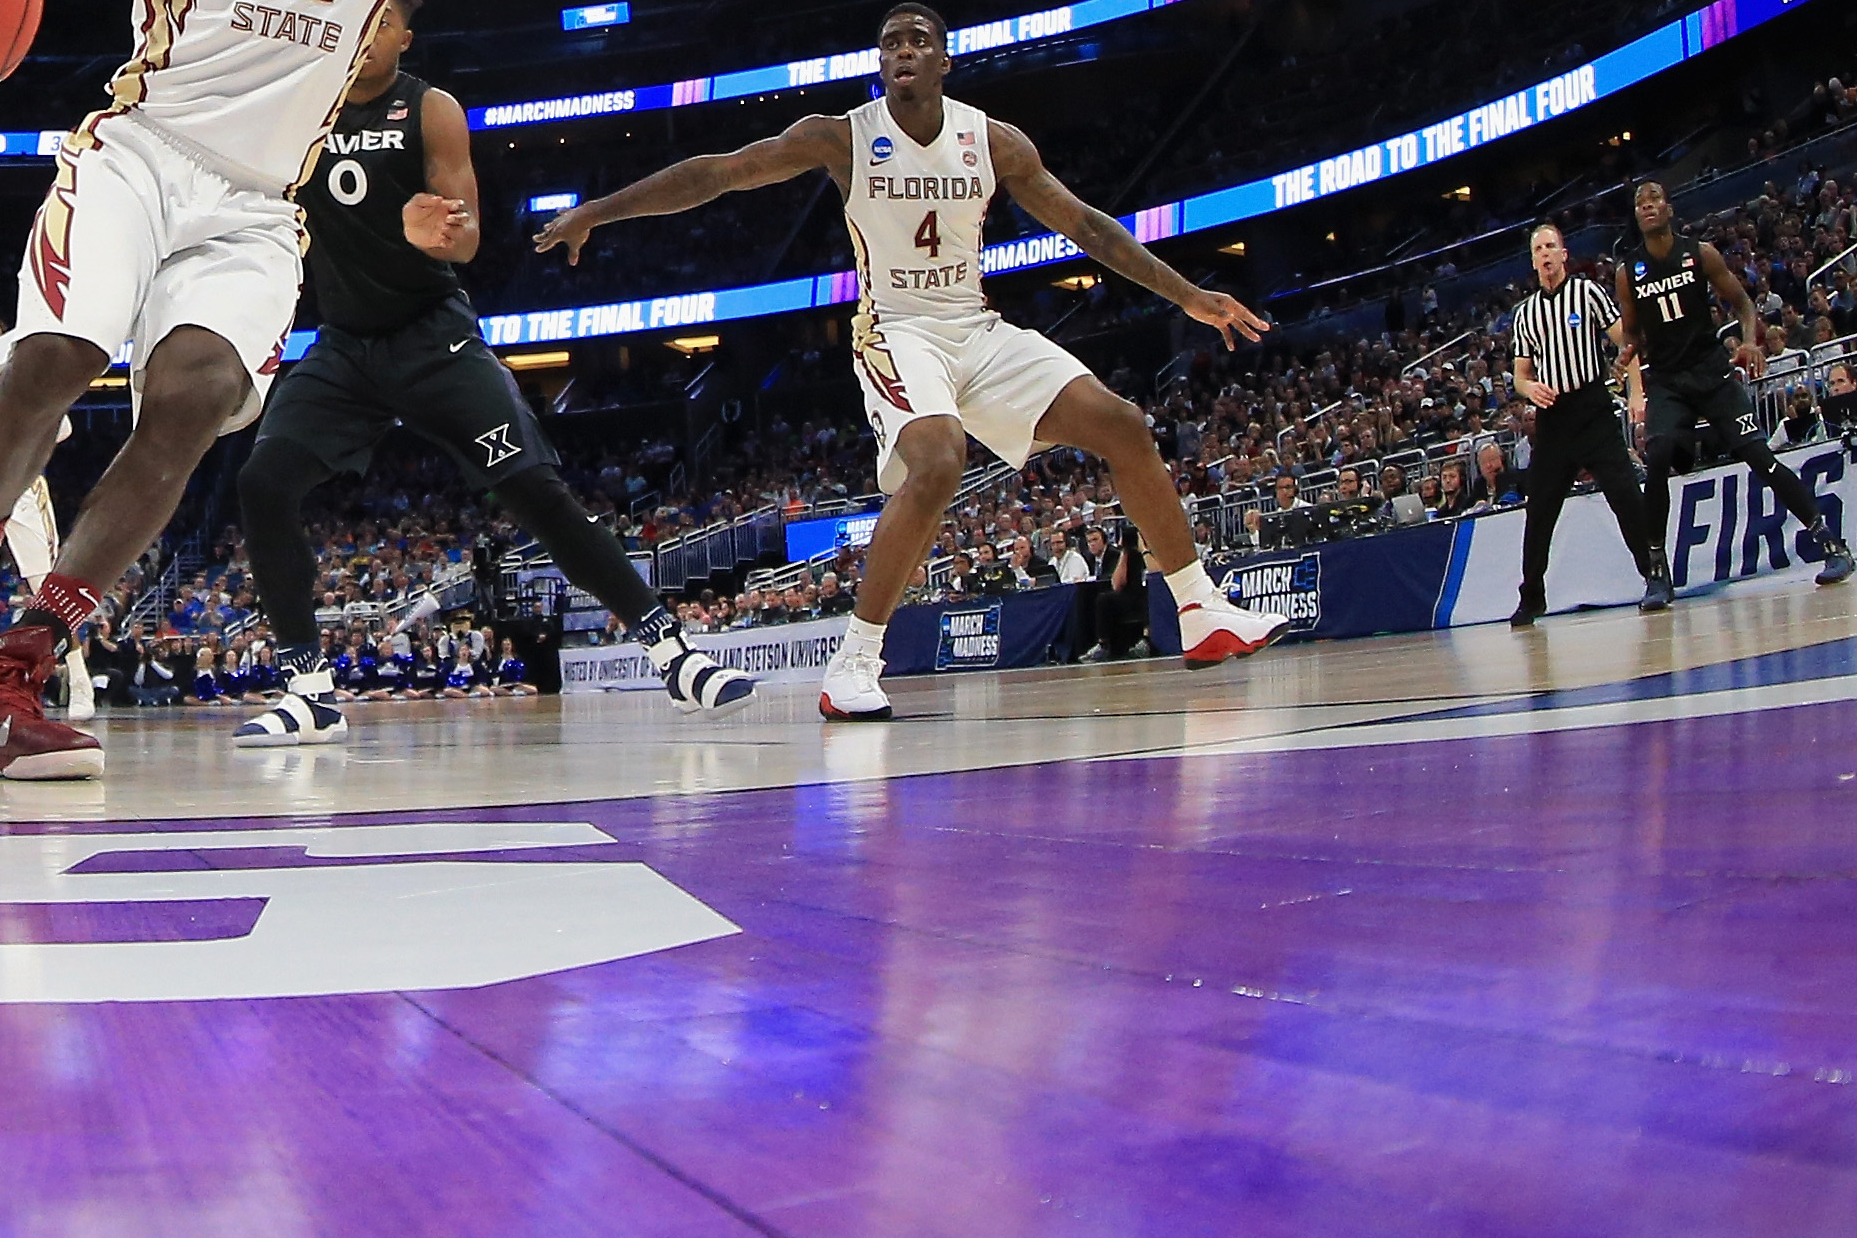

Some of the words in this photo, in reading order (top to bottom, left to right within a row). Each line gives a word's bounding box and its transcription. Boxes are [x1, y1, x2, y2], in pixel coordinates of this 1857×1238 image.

[230, 2, 344, 54] STATE
[958, 16, 1016, 54] FINAL
[1017, 6, 1072, 43] FOUR
[787, 59, 827, 87] THE
[484, 89, 636, 126] #MARCHMADNESS
[323, 129, 406, 156] AVIER
[1272, 164, 1316, 208] THE
[1319, 145, 1382, 195] ROAD
[1386, 133, 1417, 174] TO
[1422, 116, 1465, 162] THE
[1467, 91, 1533, 147] FINAL
[1535, 64, 1596, 122] FOUR
[327, 158, 369, 207] 0
[868, 176, 984, 201] FLORIDA
[914, 210, 942, 259] 4
[889, 261, 968, 290] STATE
[1634, 270, 1696, 299] XAVIER
[489, 314, 521, 344] TO
[528, 310, 574, 342] THE
[577, 301, 644, 337] FINAL
[650, 292, 715, 328] FOUR
[1657, 292, 1685, 323] 11
[1673, 450, 1857, 588] FIRS
[1242, 566, 1293, 599] MARCH
[950, 614, 984, 637] MARCH
[744, 642, 789, 671] STETSON
[953, 635, 999, 658] MADNESS
